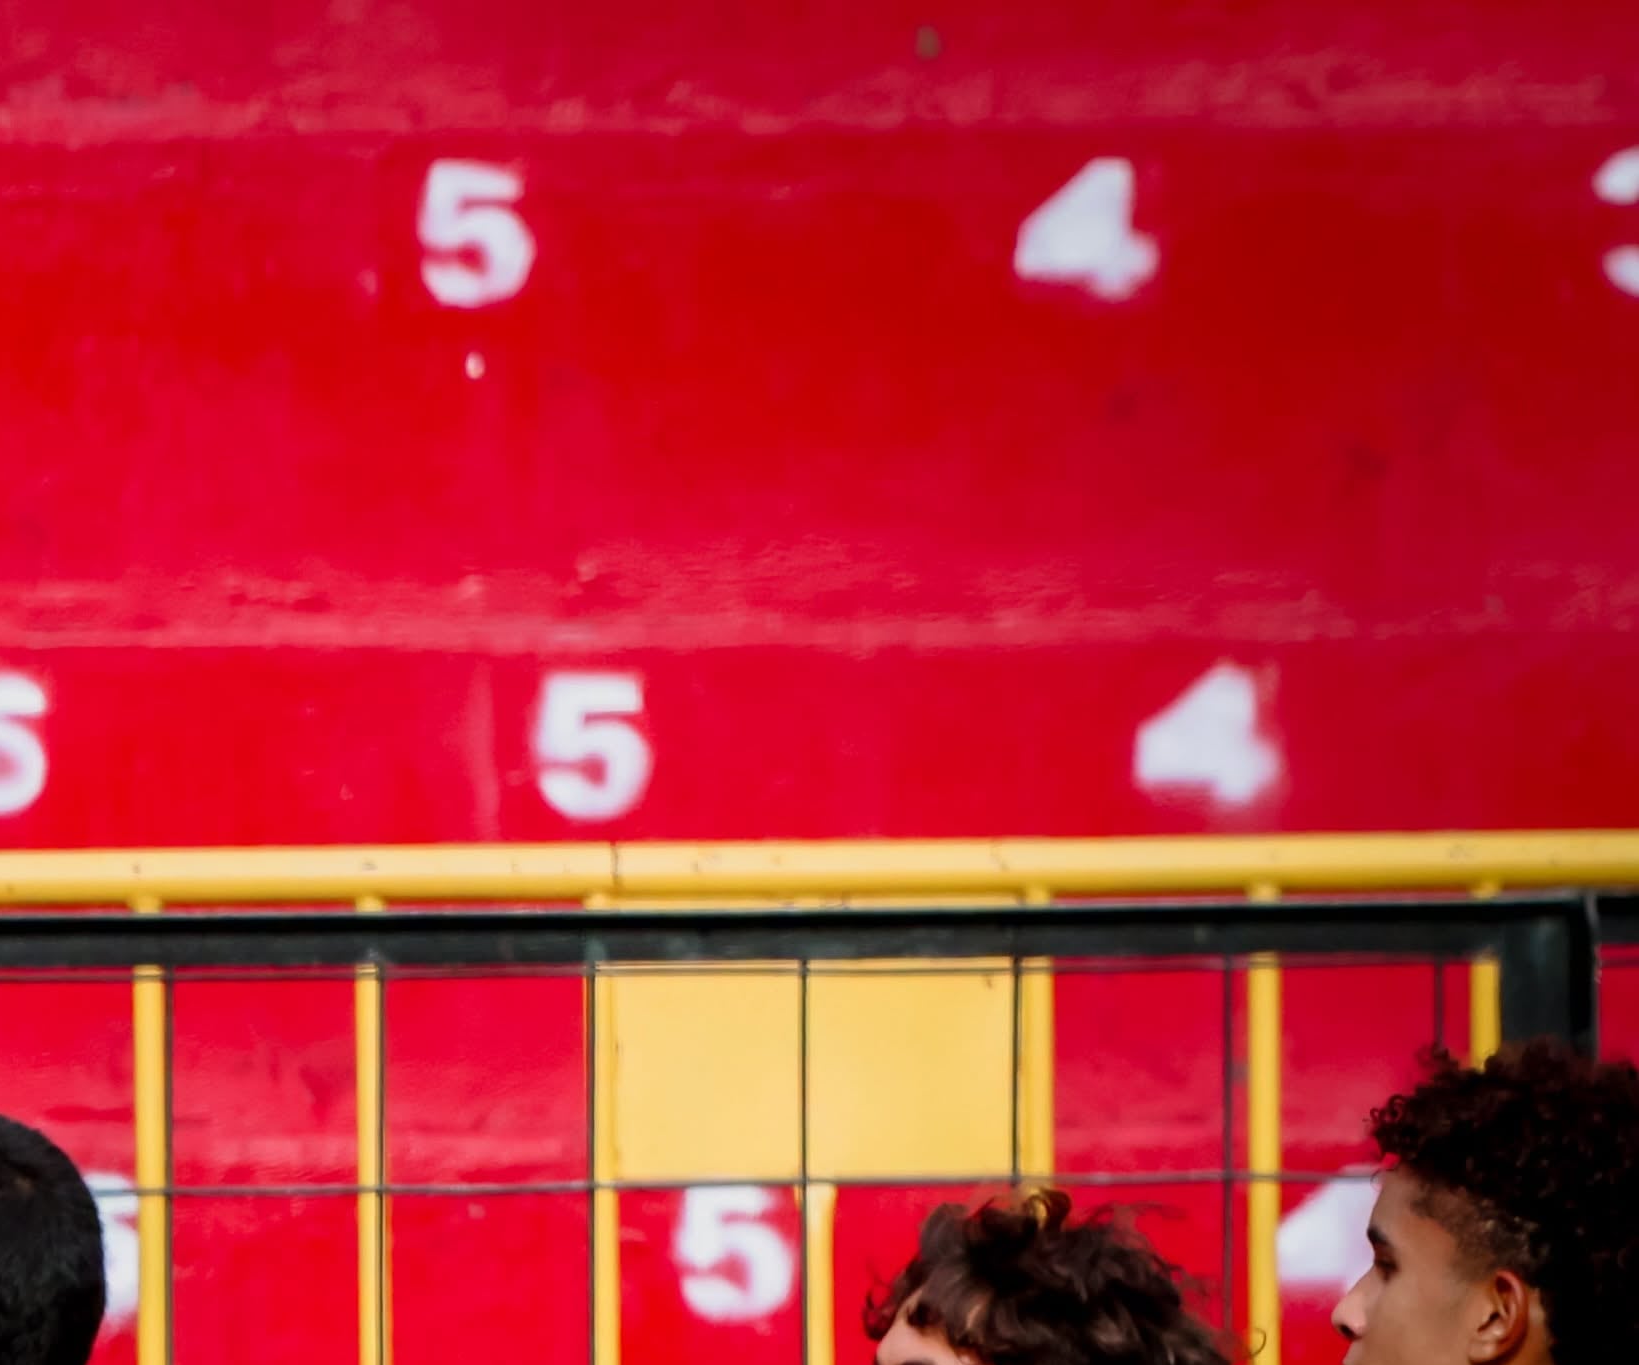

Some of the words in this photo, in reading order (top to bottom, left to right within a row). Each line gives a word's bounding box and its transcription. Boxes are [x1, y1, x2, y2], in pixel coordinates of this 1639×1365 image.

[417, 158, 535, 308] 5
[1013, 156, 1159, 302] 4
[532, 671, 652, 821] 5
[1133, 661, 1284, 810] 4
[672, 1184, 795, 1324] 5
